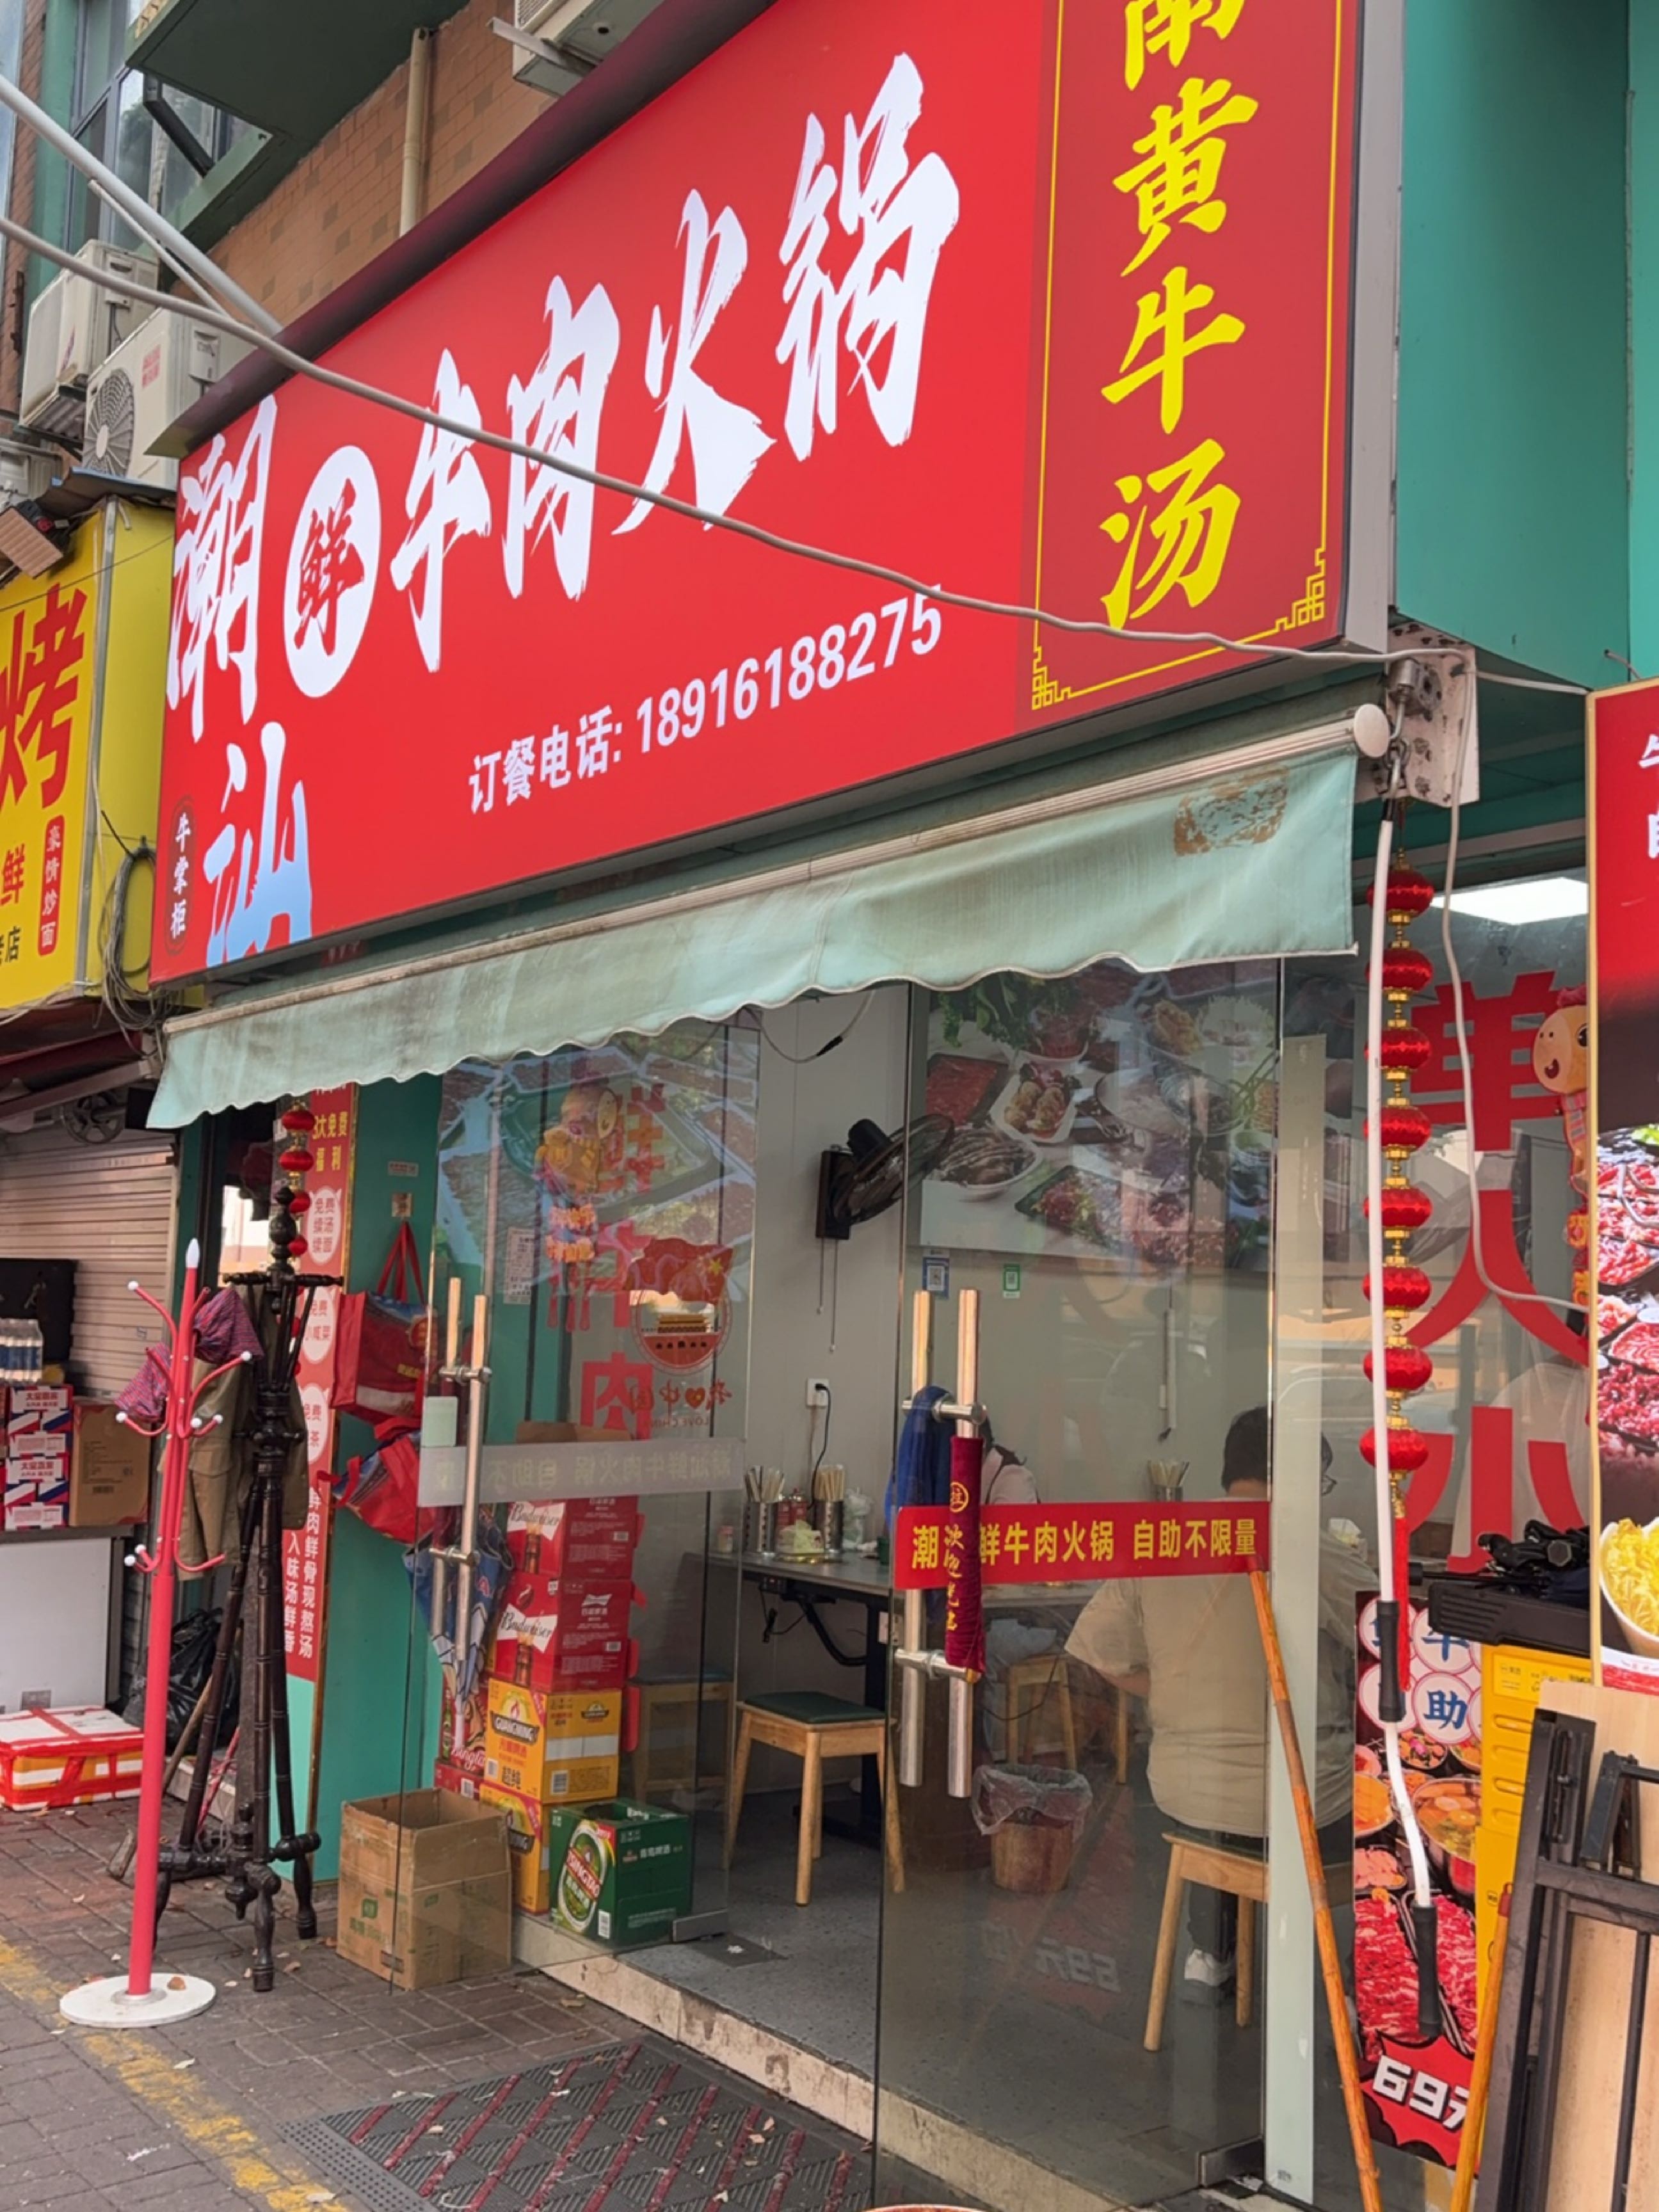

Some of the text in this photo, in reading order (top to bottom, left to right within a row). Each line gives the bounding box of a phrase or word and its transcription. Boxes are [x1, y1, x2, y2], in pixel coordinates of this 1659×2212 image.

[0, 582, 88, 809] 烤
[636, 584, 943, 753] 18916188275
[0, 926, 21, 963] 店
[911, 1518, 1258, 1570] 潮鲜牛肉火锅 自助不限量
